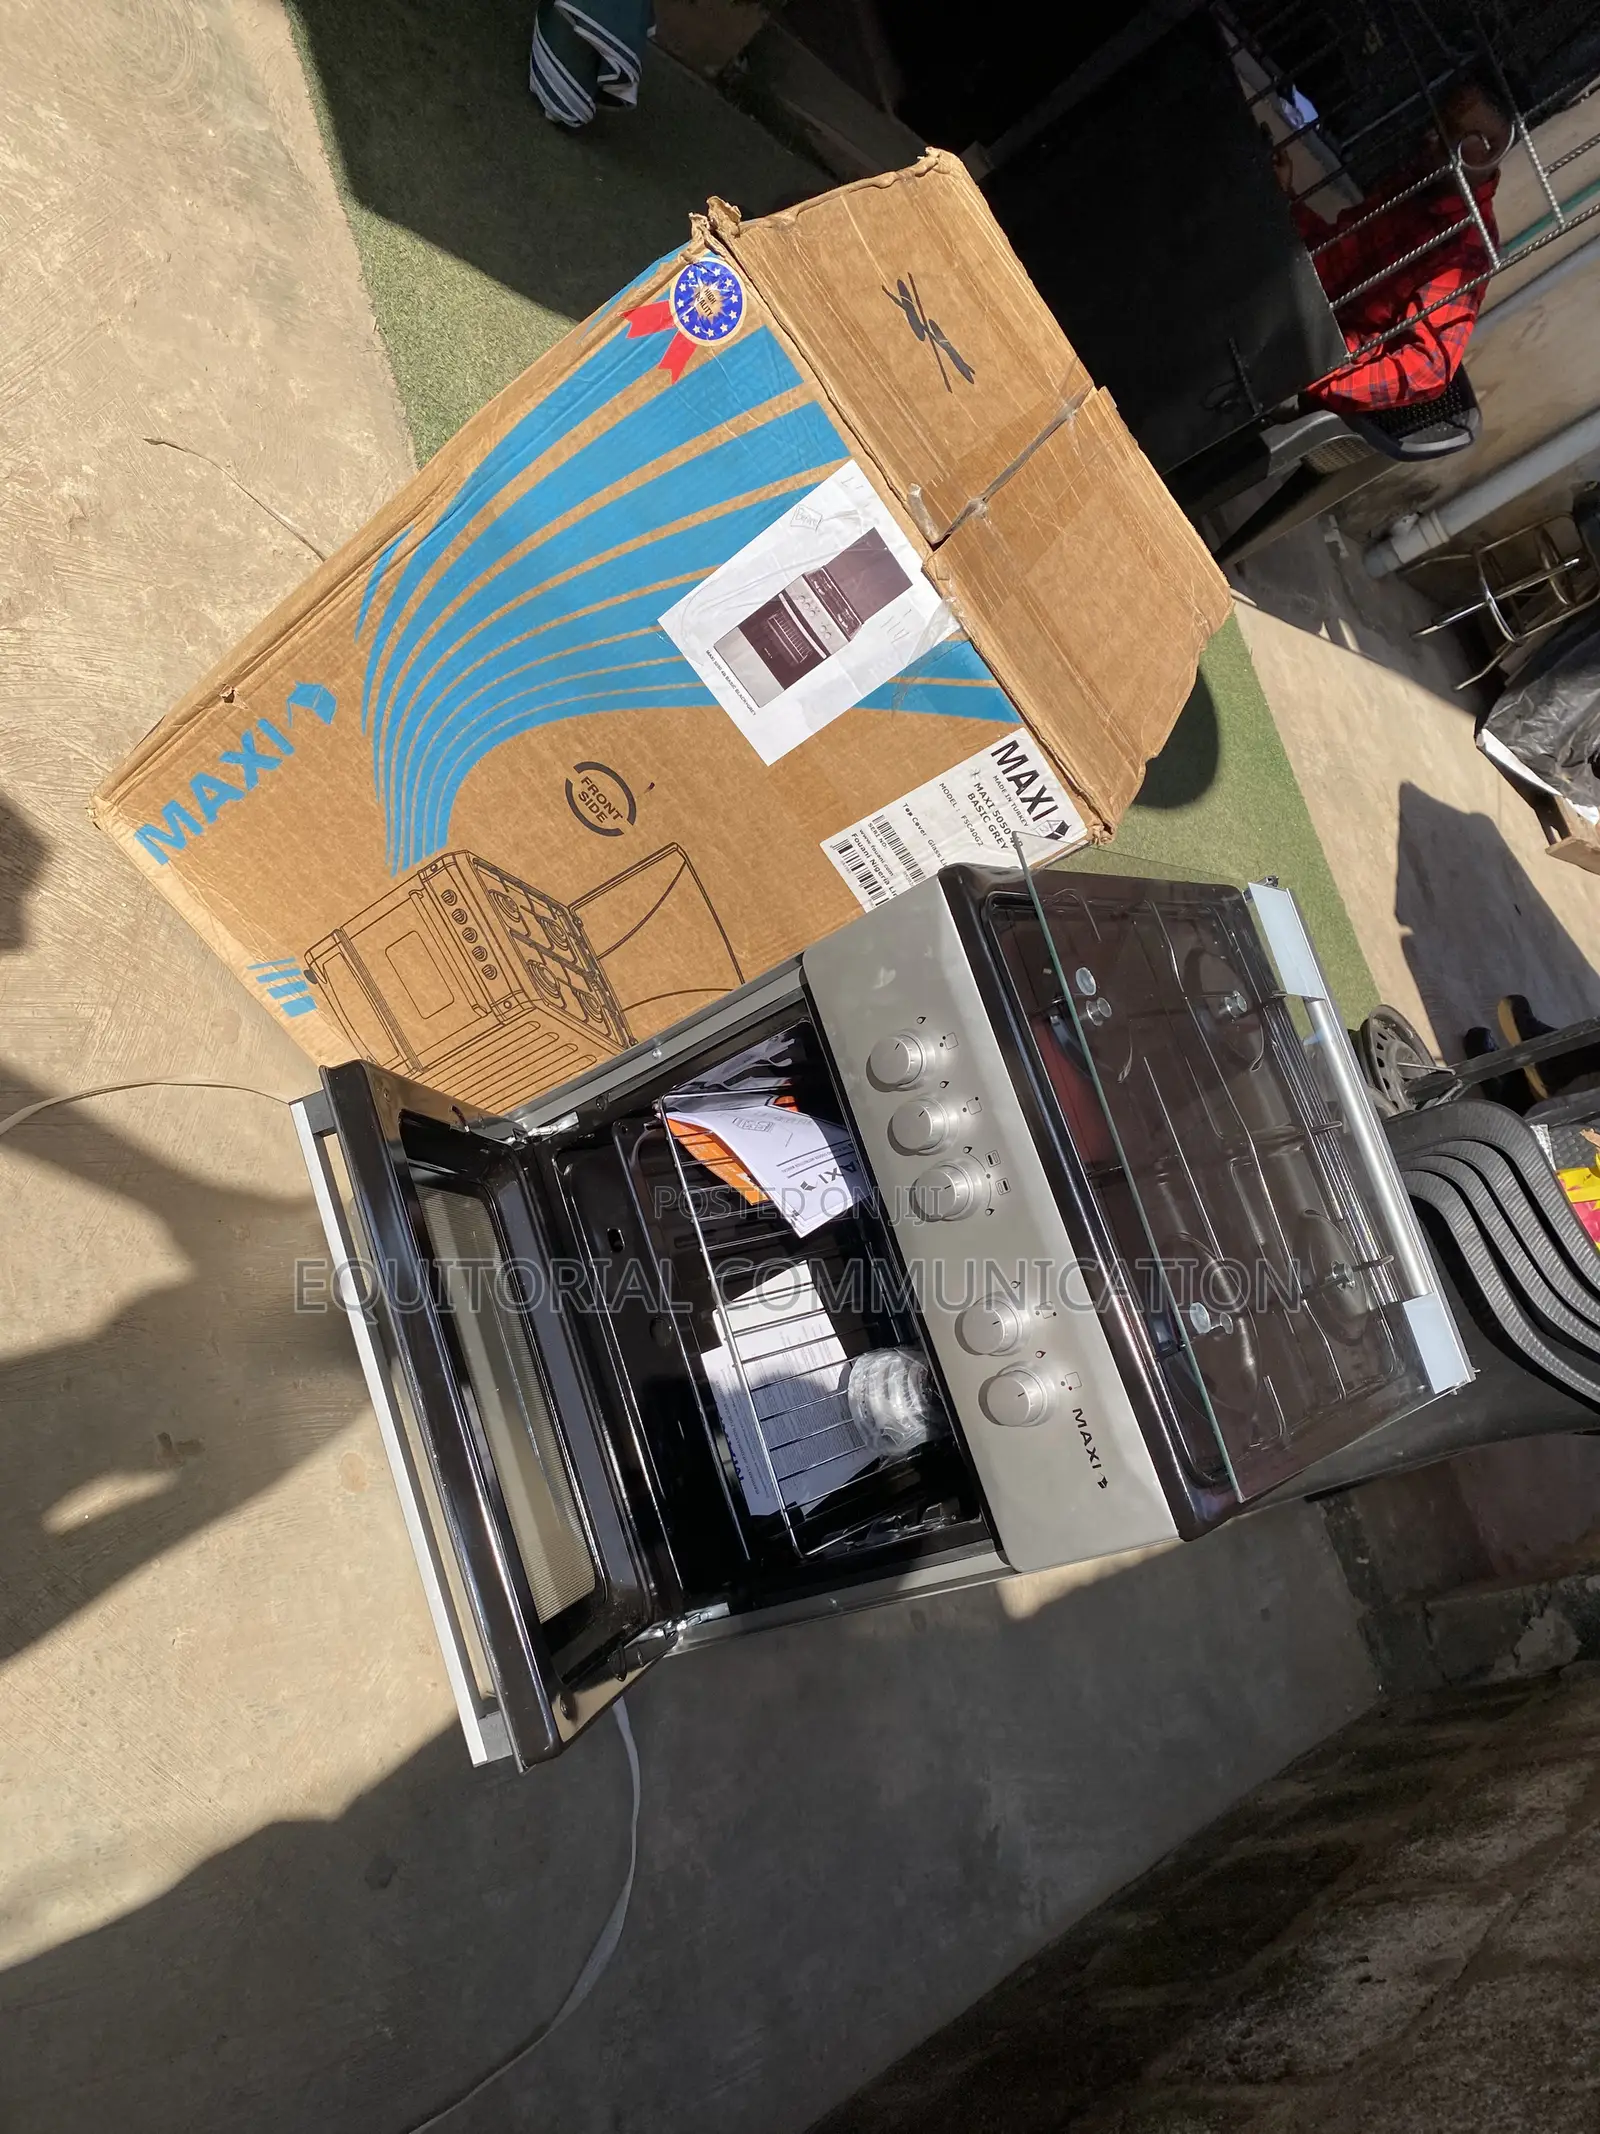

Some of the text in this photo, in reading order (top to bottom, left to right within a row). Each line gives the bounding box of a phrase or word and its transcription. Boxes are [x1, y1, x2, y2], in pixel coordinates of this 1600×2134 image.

[703, 288, 717, 305] HIGH
[134, 716, 295, 865] MAXI
[578, 791, 608, 823] SIDE
[581, 776, 623, 820] FRONT
[939, 782, 958, 808] MODEL
[990, 740, 1060, 822] MAXI
[992, 775, 1029, 828] MADE IN TURKEY
[902, 803, 914, 817] Top
[911, 816, 928, 838] Cover
[927, 838, 943, 859] Glass
[967, 792, 1009, 851] BASIC GREY
[974, 782, 995, 810] MAXI
[992, 810, 1012, 836] 5050
[851, 832, 872, 860] Fouani
[869, 858, 891, 887] Nigeria
[1072, 1408, 1102, 1469] MAXI
